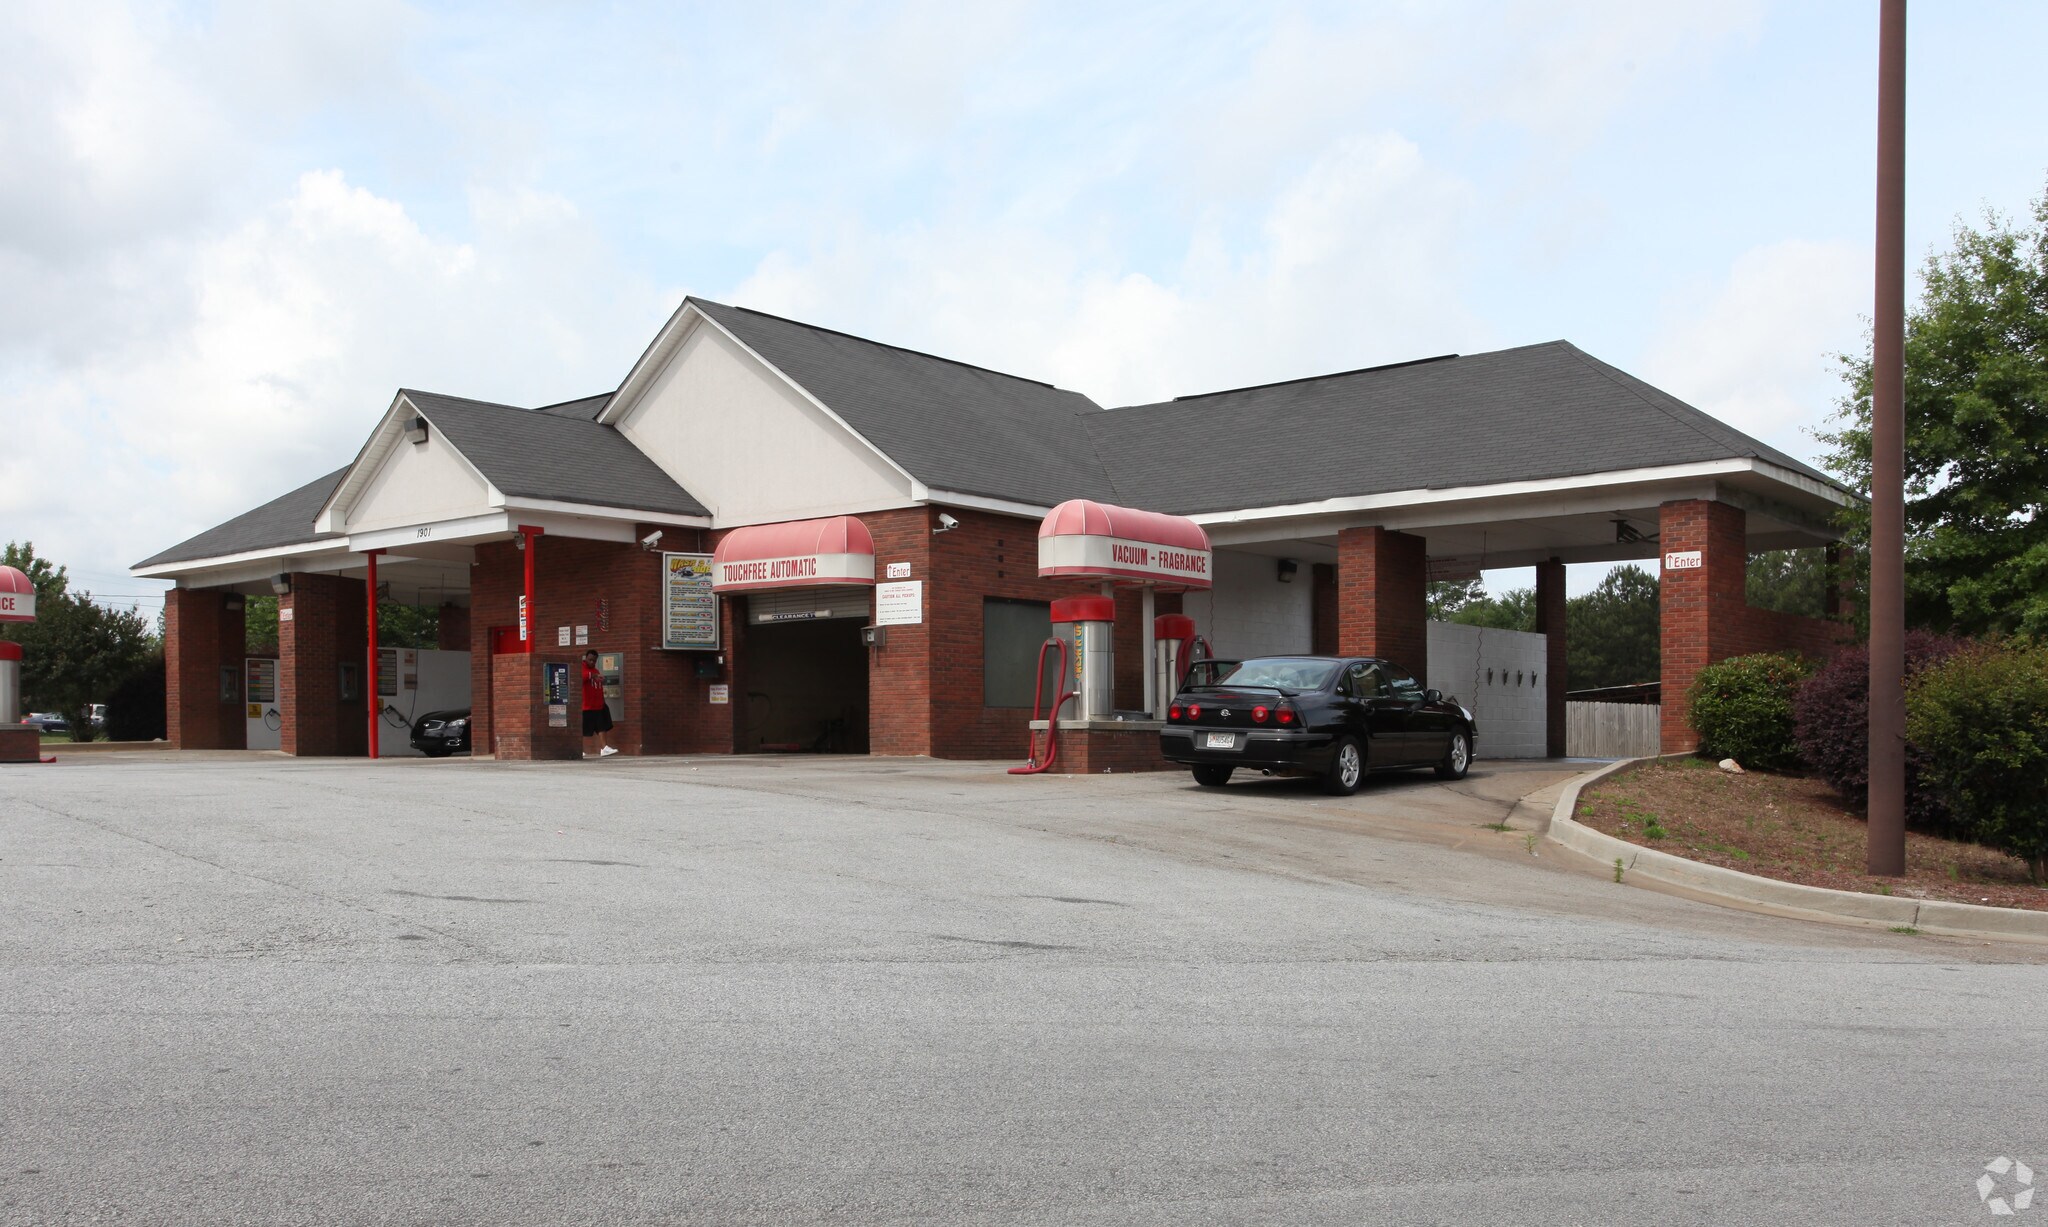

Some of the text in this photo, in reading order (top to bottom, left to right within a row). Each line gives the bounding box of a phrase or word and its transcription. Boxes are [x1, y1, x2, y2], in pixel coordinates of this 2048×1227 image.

[416, 527, 432, 538] 1901
[1112, 543, 1148, 566] VACUUM
[1158, 550, 1206, 574] FRAGRANCE
[1674, 556, 1700, 568] Enter
[723, 557, 817, 582] TOUCHFREE AUTOMATIC
[892, 567, 910, 577] Enter
[772, 612, 810, 621] CLEARANCE
